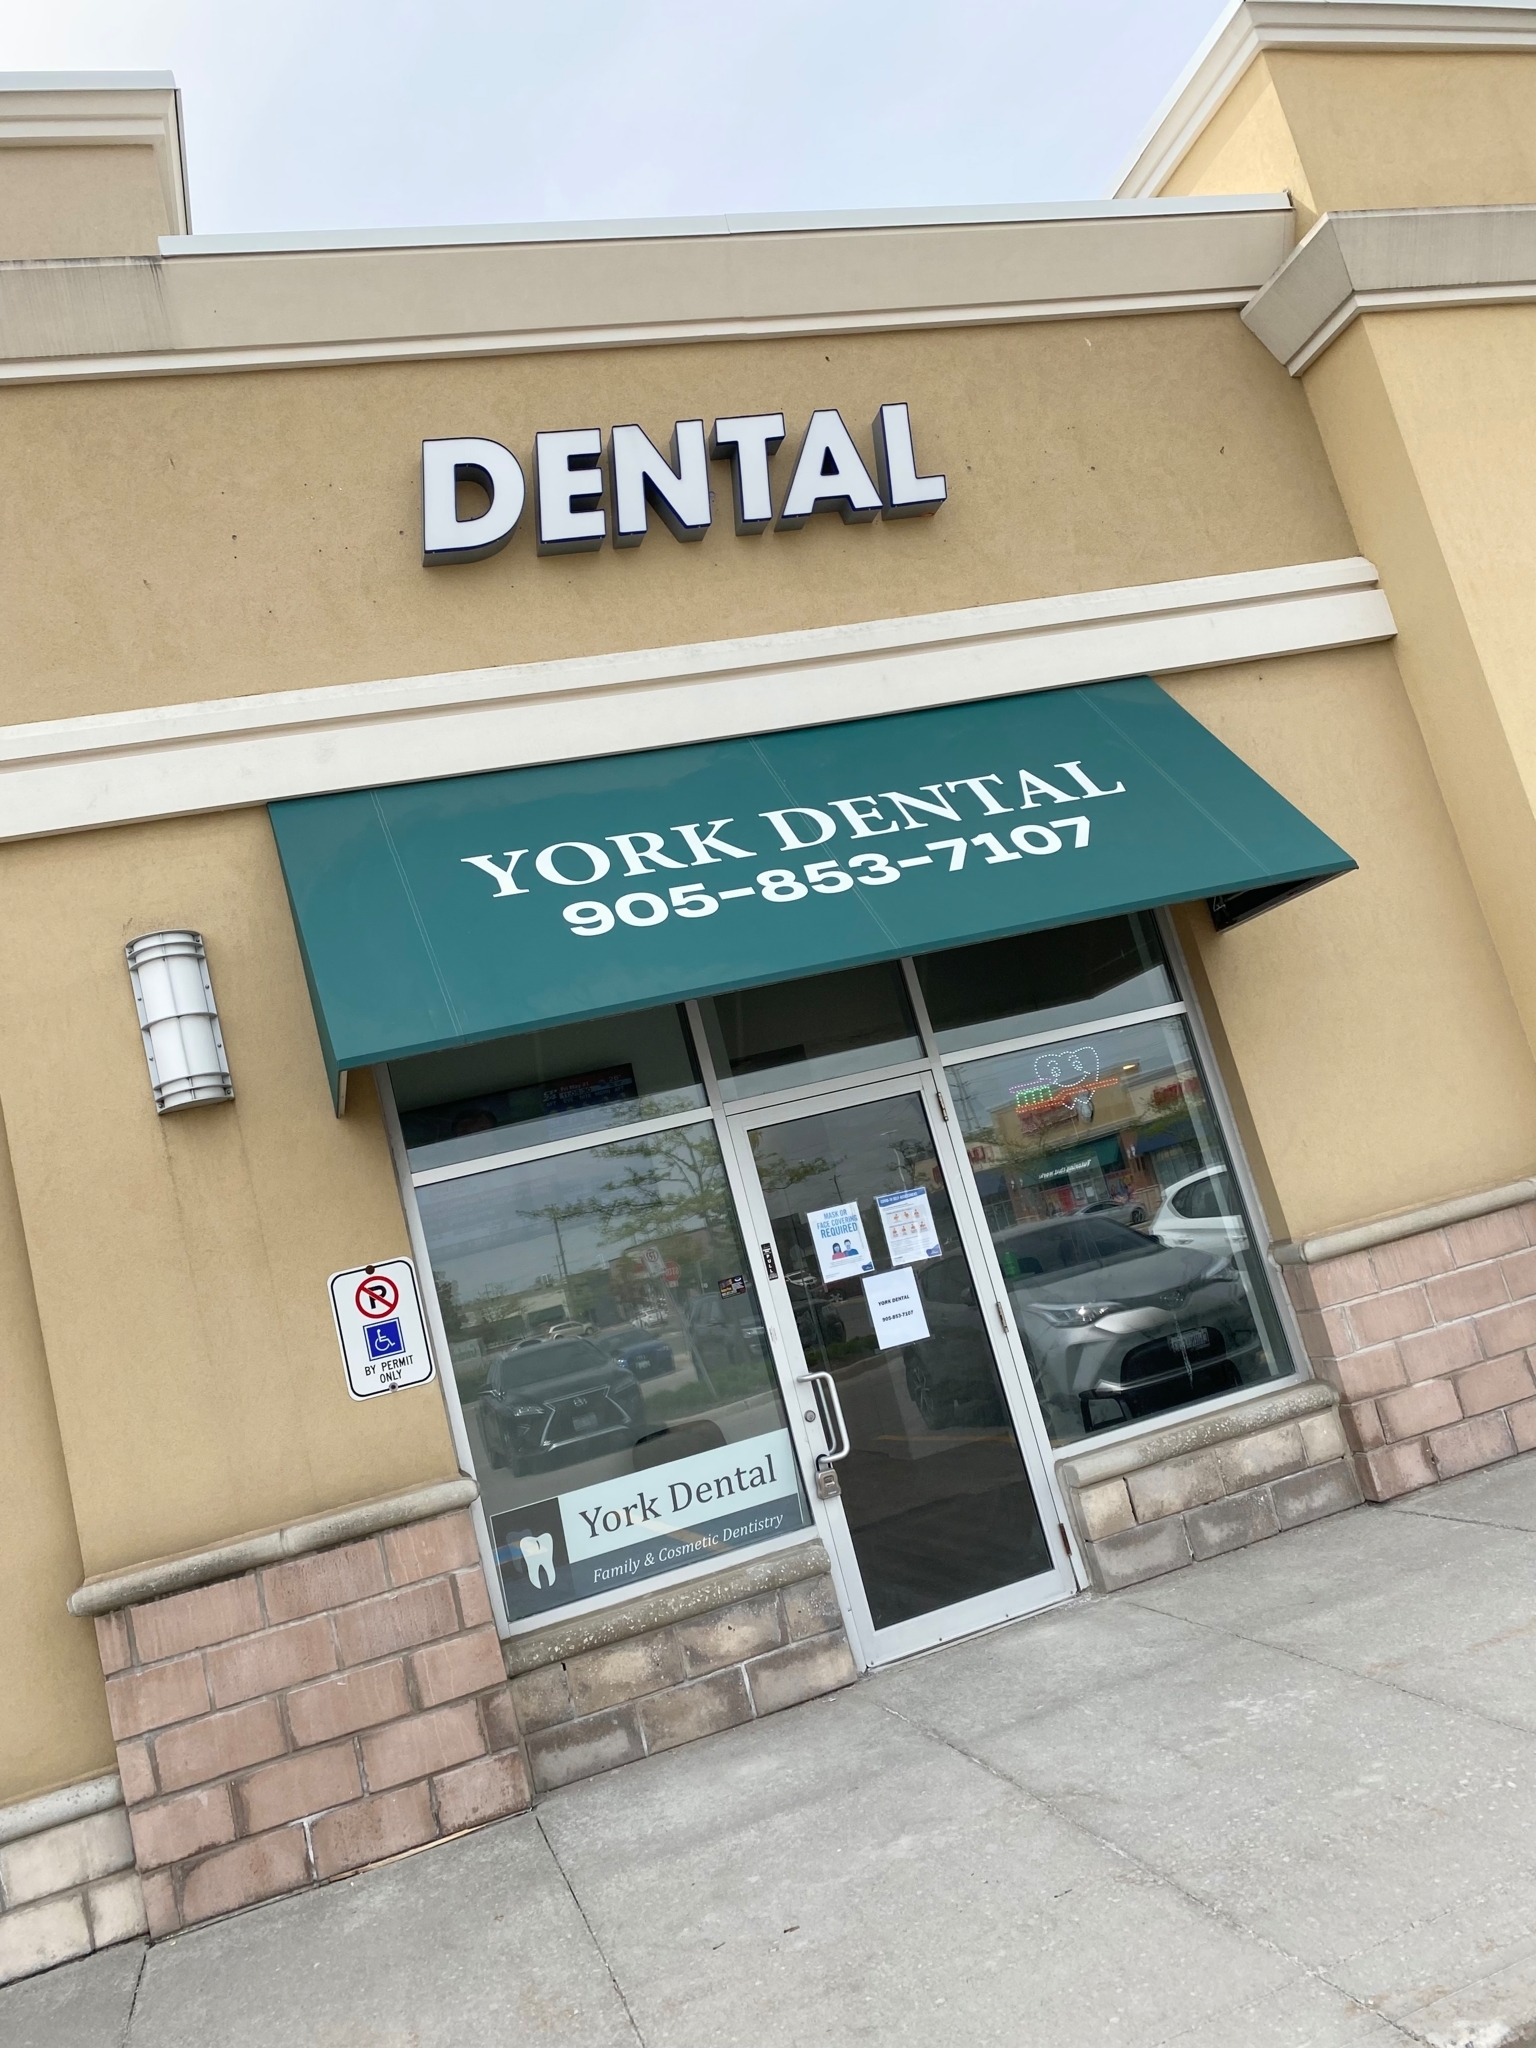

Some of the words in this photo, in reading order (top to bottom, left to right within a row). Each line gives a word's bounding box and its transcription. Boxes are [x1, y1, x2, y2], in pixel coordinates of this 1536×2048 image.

[421, 402, 948, 562] DENTAL
[460, 817, 757, 898] YORK
[759, 760, 1126, 851] DENTAL
[562, 815, 1092, 937] 905-853-7107
[817, 1221, 831, 1230] FACE
[831, 1214, 858, 1227] COVERING
[823, 1211, 839, 1220] MASK
[840, 1208, 847, 1216] OR
[820, 1222, 858, 1239] REQUIRED
[892, 1294, 910, 1303] DENTAL
[882, 1310, 914, 1322] 905-853-7107
[364, 1364, 376, 1376] BY
[381, 1355, 413, 1372] PERMIT
[380, 1369, 402, 1383] ONLY
[578, 1492, 662, 1538] York
[668, 1454, 778, 1513] Dental
[593, 1556, 641, 1583] Family
[644, 1552, 655, 1567] &
[658, 1534, 719, 1562] Cosmetic
[722, 1514, 784, 1542] Dentistry
